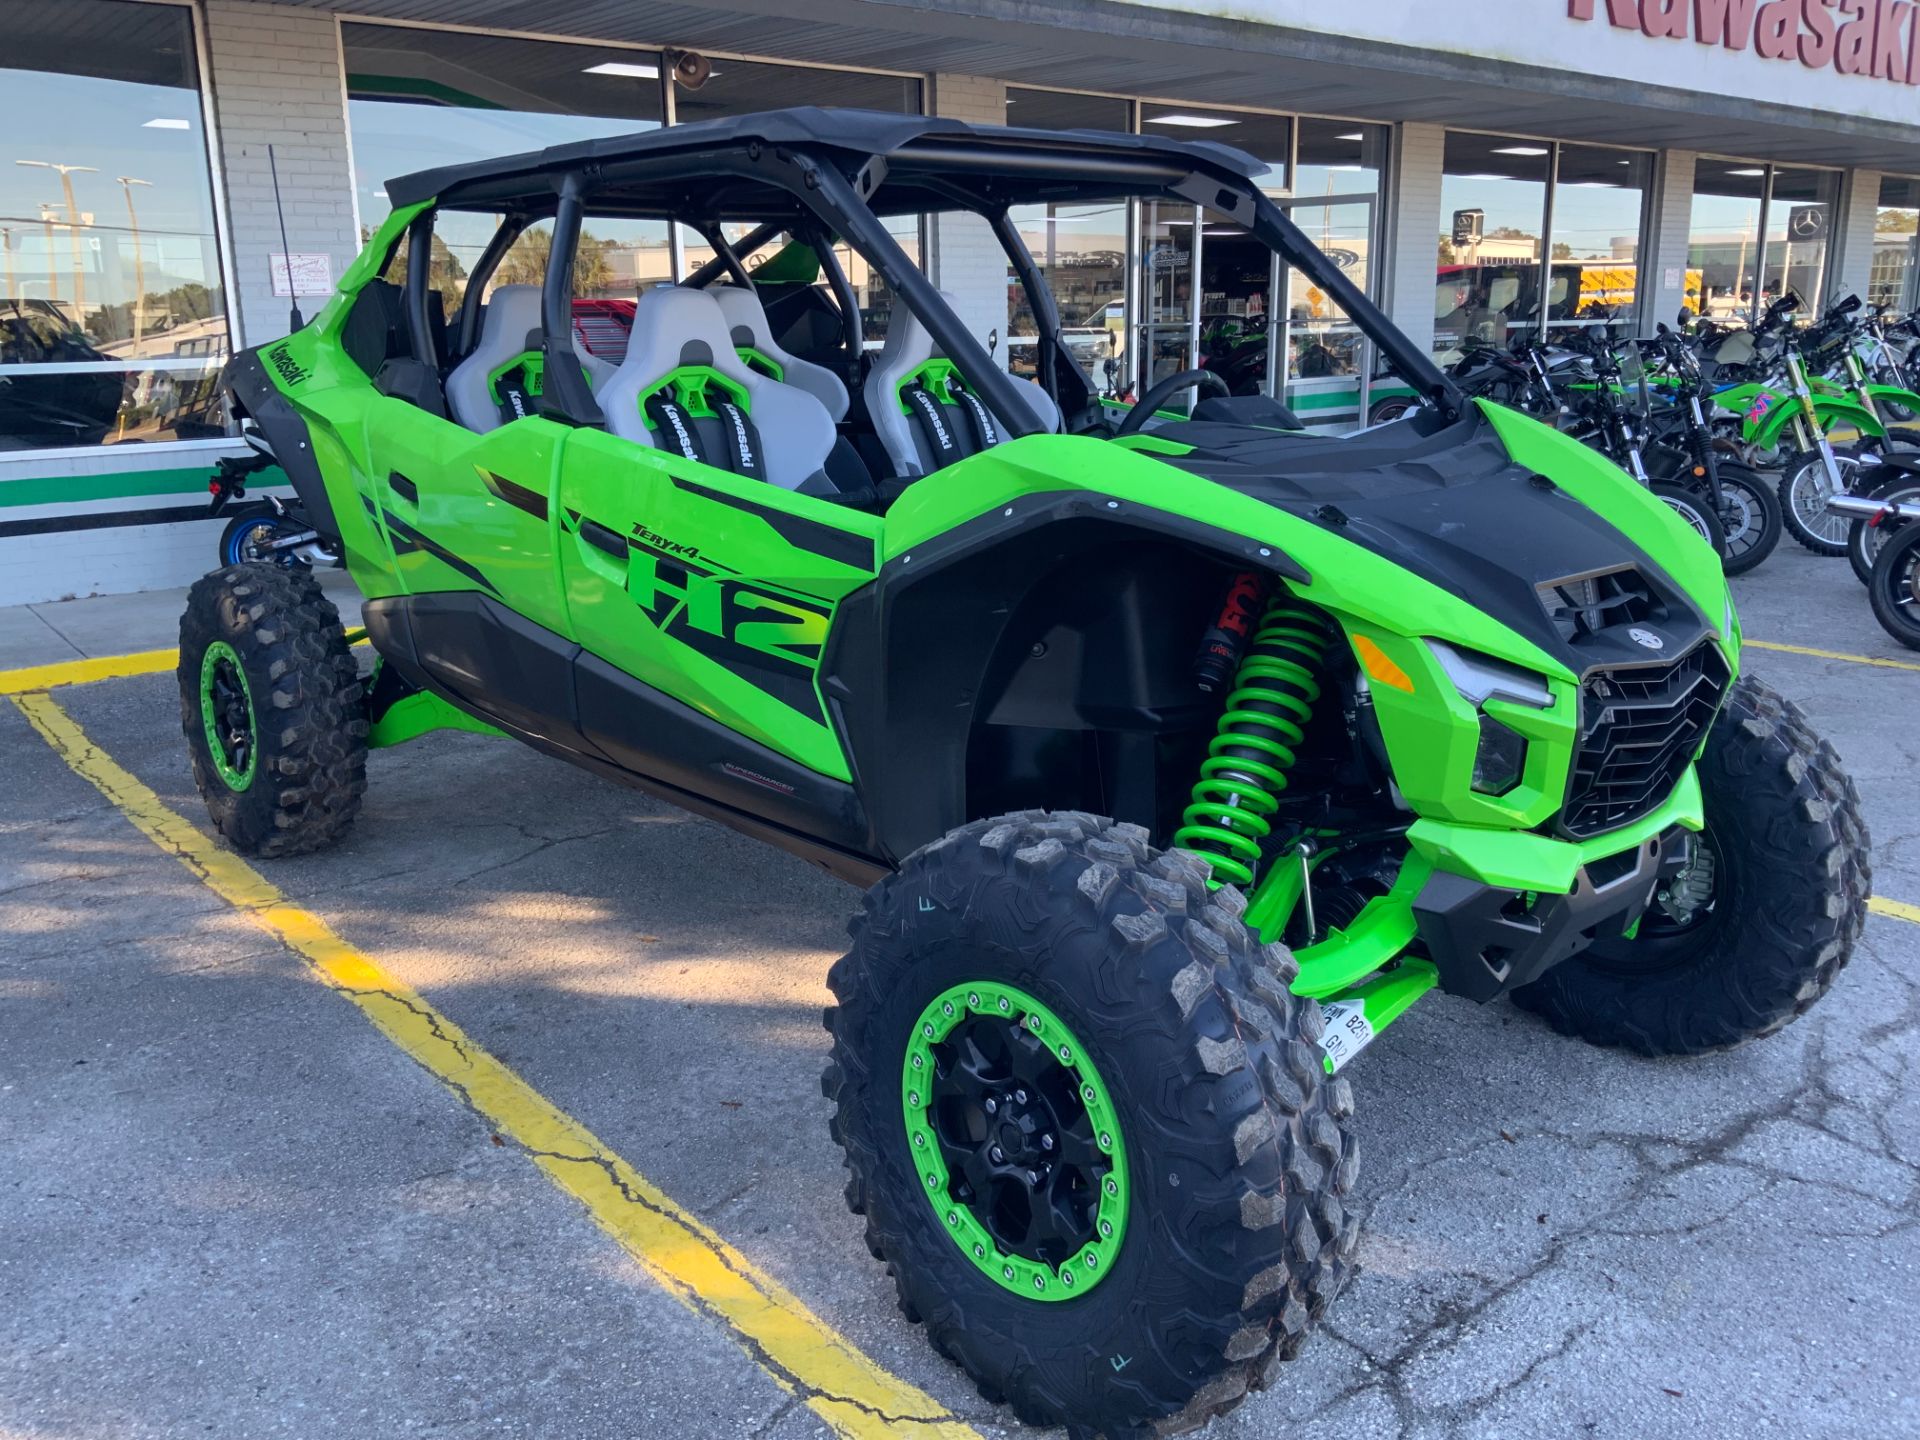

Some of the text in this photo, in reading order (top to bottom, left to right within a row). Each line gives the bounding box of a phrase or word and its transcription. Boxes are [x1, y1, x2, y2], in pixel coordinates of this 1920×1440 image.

[266, 341, 313, 388] Kawasaki
[661, 404, 698, 462] Kawasak
[722, 402, 754, 468] Kawasaki
[912, 390, 953, 450] Kawasaki
[626, 546, 831, 670] H2
